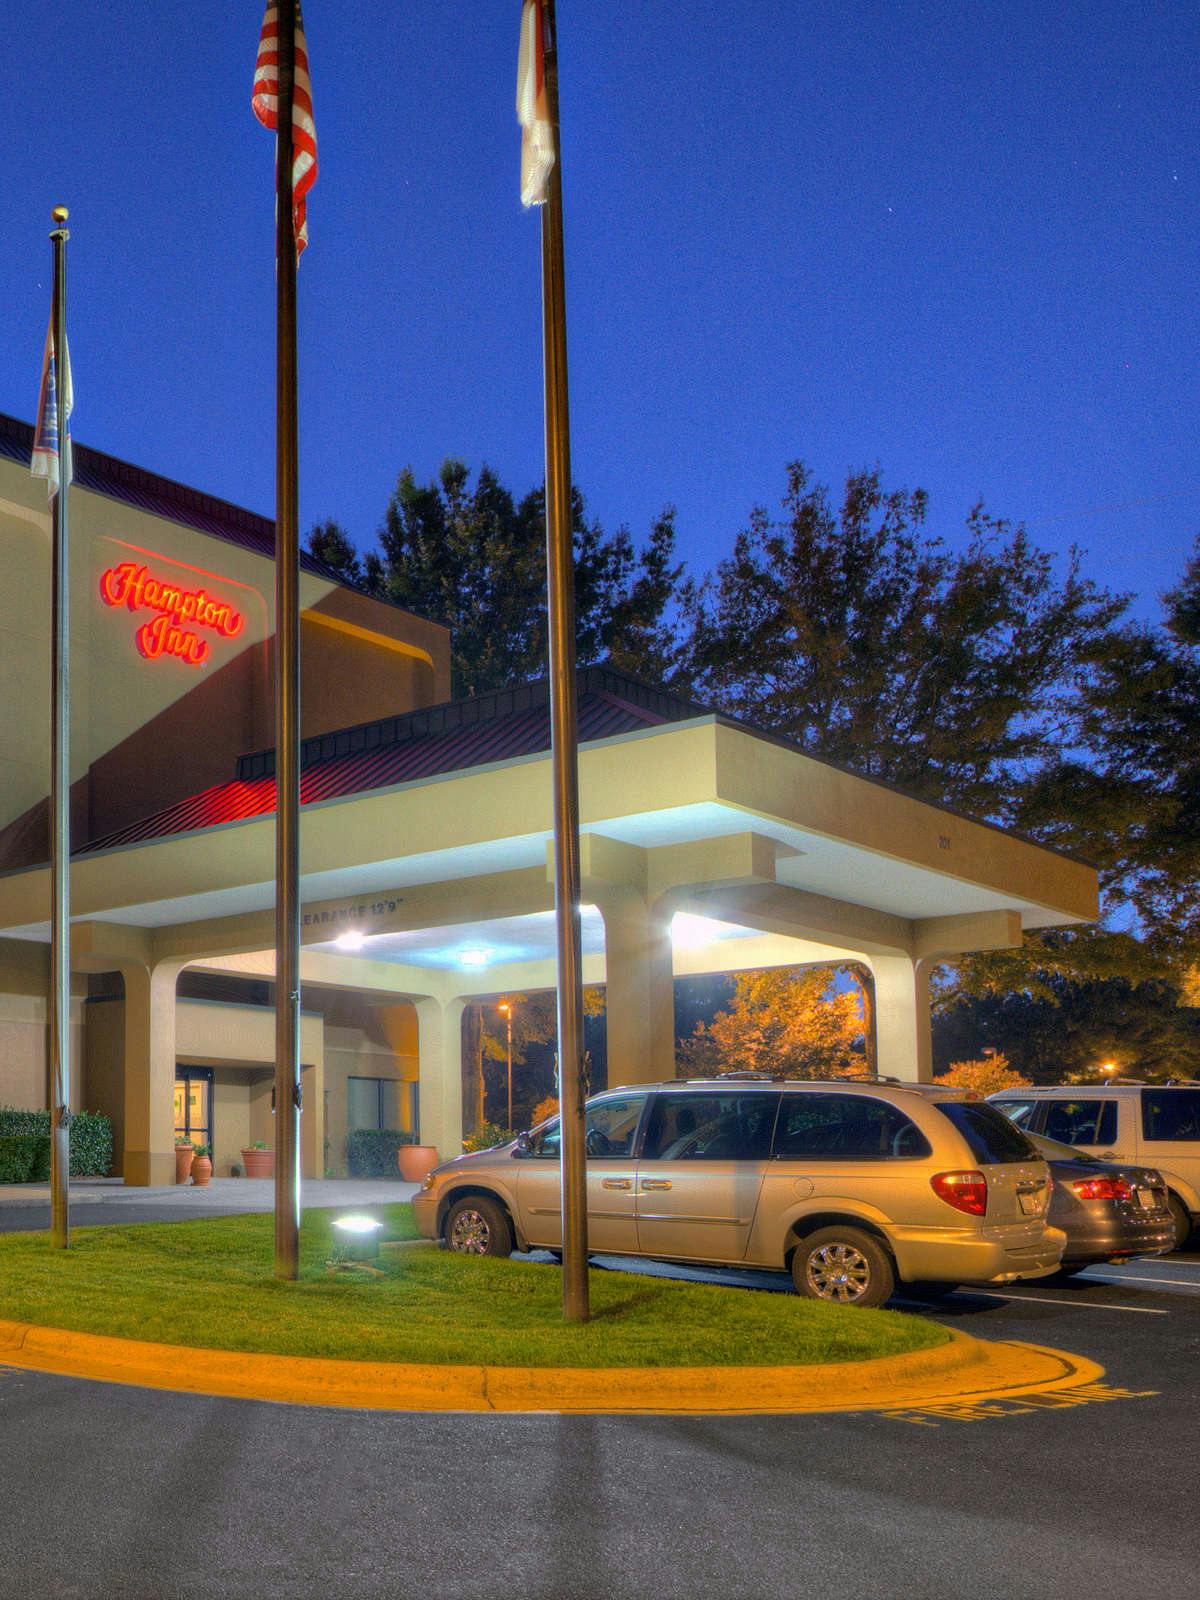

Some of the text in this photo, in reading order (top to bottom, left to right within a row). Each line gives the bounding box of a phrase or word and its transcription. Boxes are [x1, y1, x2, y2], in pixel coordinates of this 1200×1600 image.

[101, 563, 243, 637] Hampton
[135, 613, 210, 665] Inn
[877, 1383, 1162, 1427] FIRE LANE
